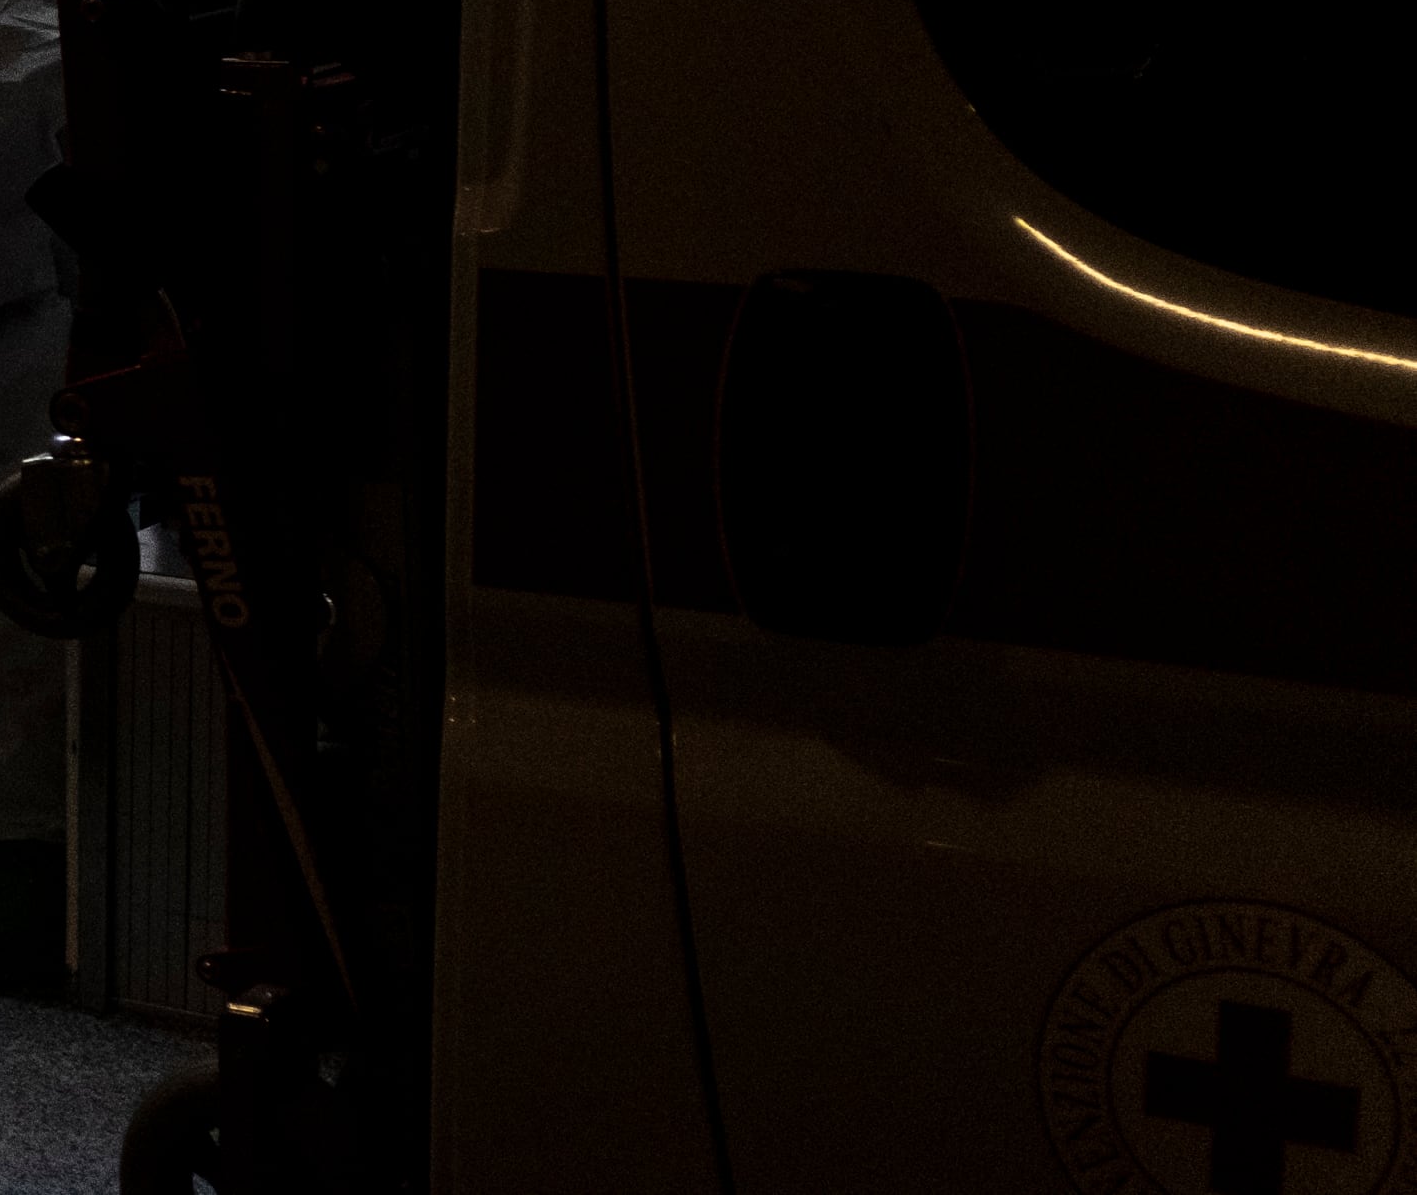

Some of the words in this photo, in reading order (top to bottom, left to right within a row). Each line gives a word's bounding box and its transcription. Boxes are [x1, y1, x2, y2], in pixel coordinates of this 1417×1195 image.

[175, 473, 252, 629] FERNO
[1099, 935, 1160, 994] DI
[1162, 910, 1375, 1009] GINEVRA
